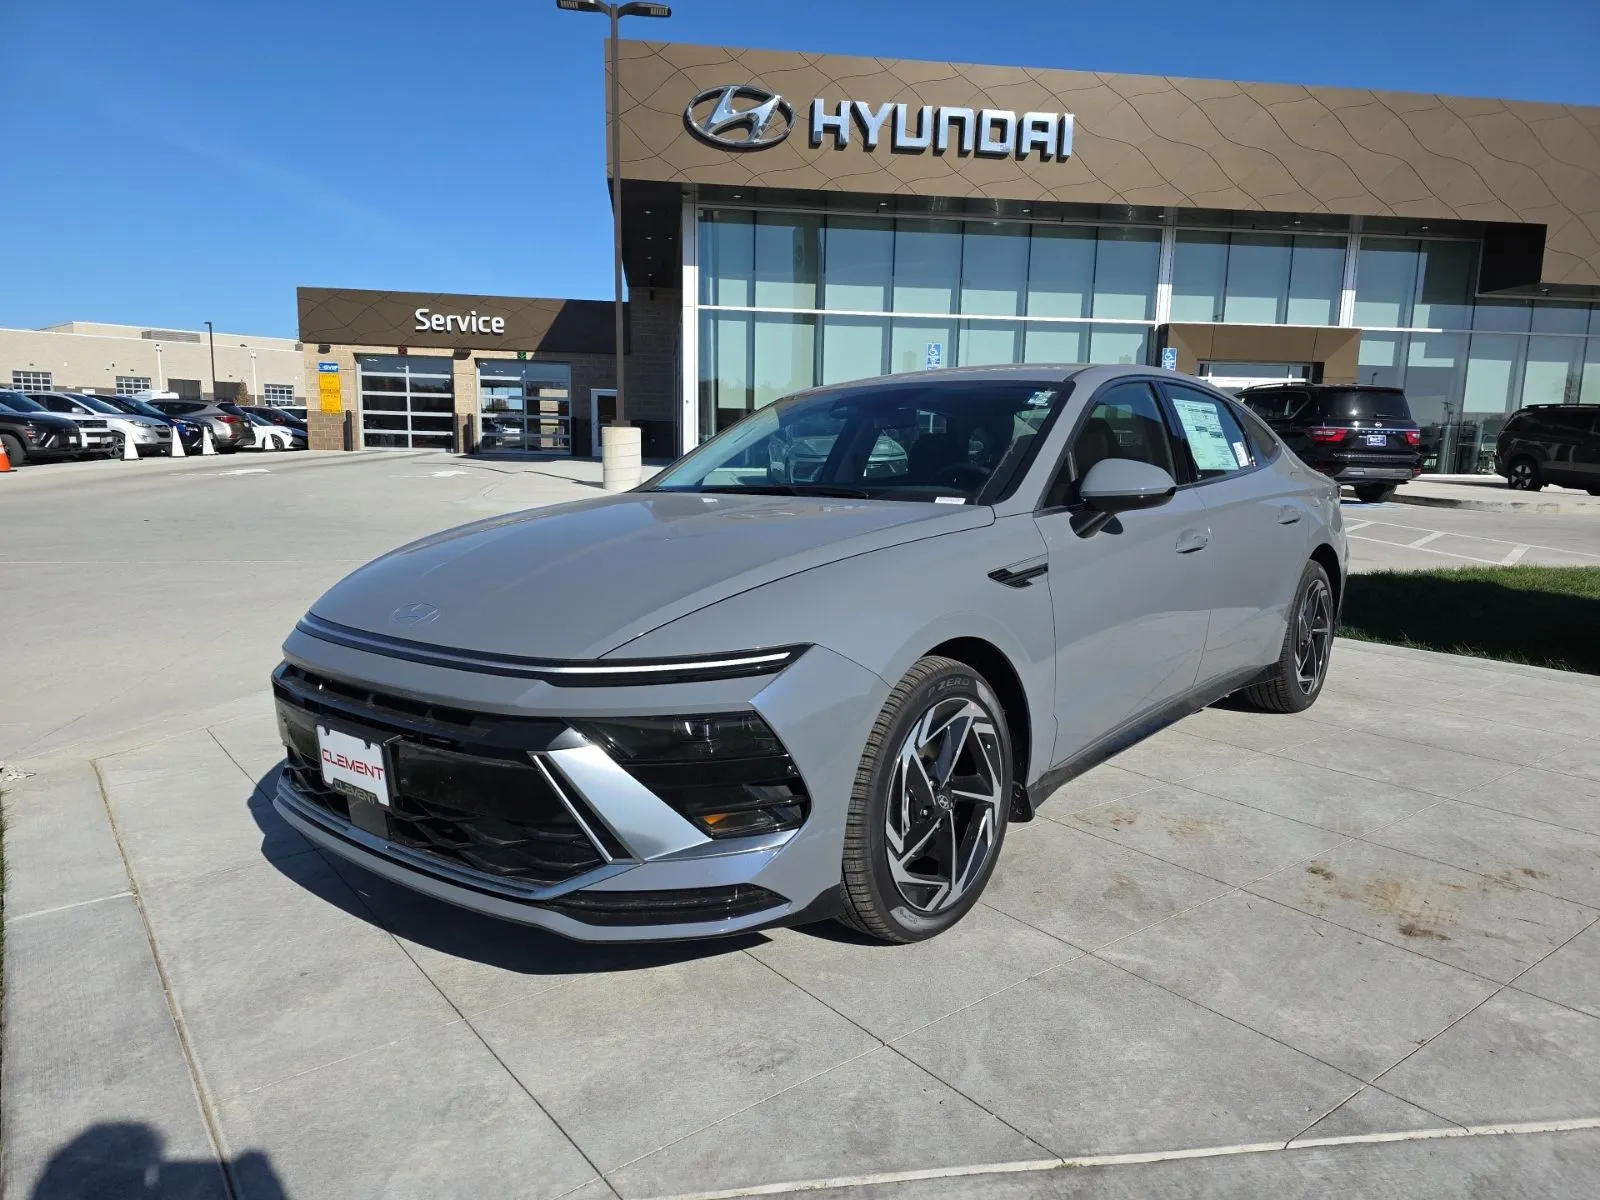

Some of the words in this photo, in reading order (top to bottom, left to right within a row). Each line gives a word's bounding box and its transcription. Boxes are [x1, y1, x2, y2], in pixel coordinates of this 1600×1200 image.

[809, 98, 1075, 161] HYUNDAI
[415, 308, 505, 335] Service
[322, 749, 384, 780] CLEMENT
[334, 781, 377, 804] CLEMENT
